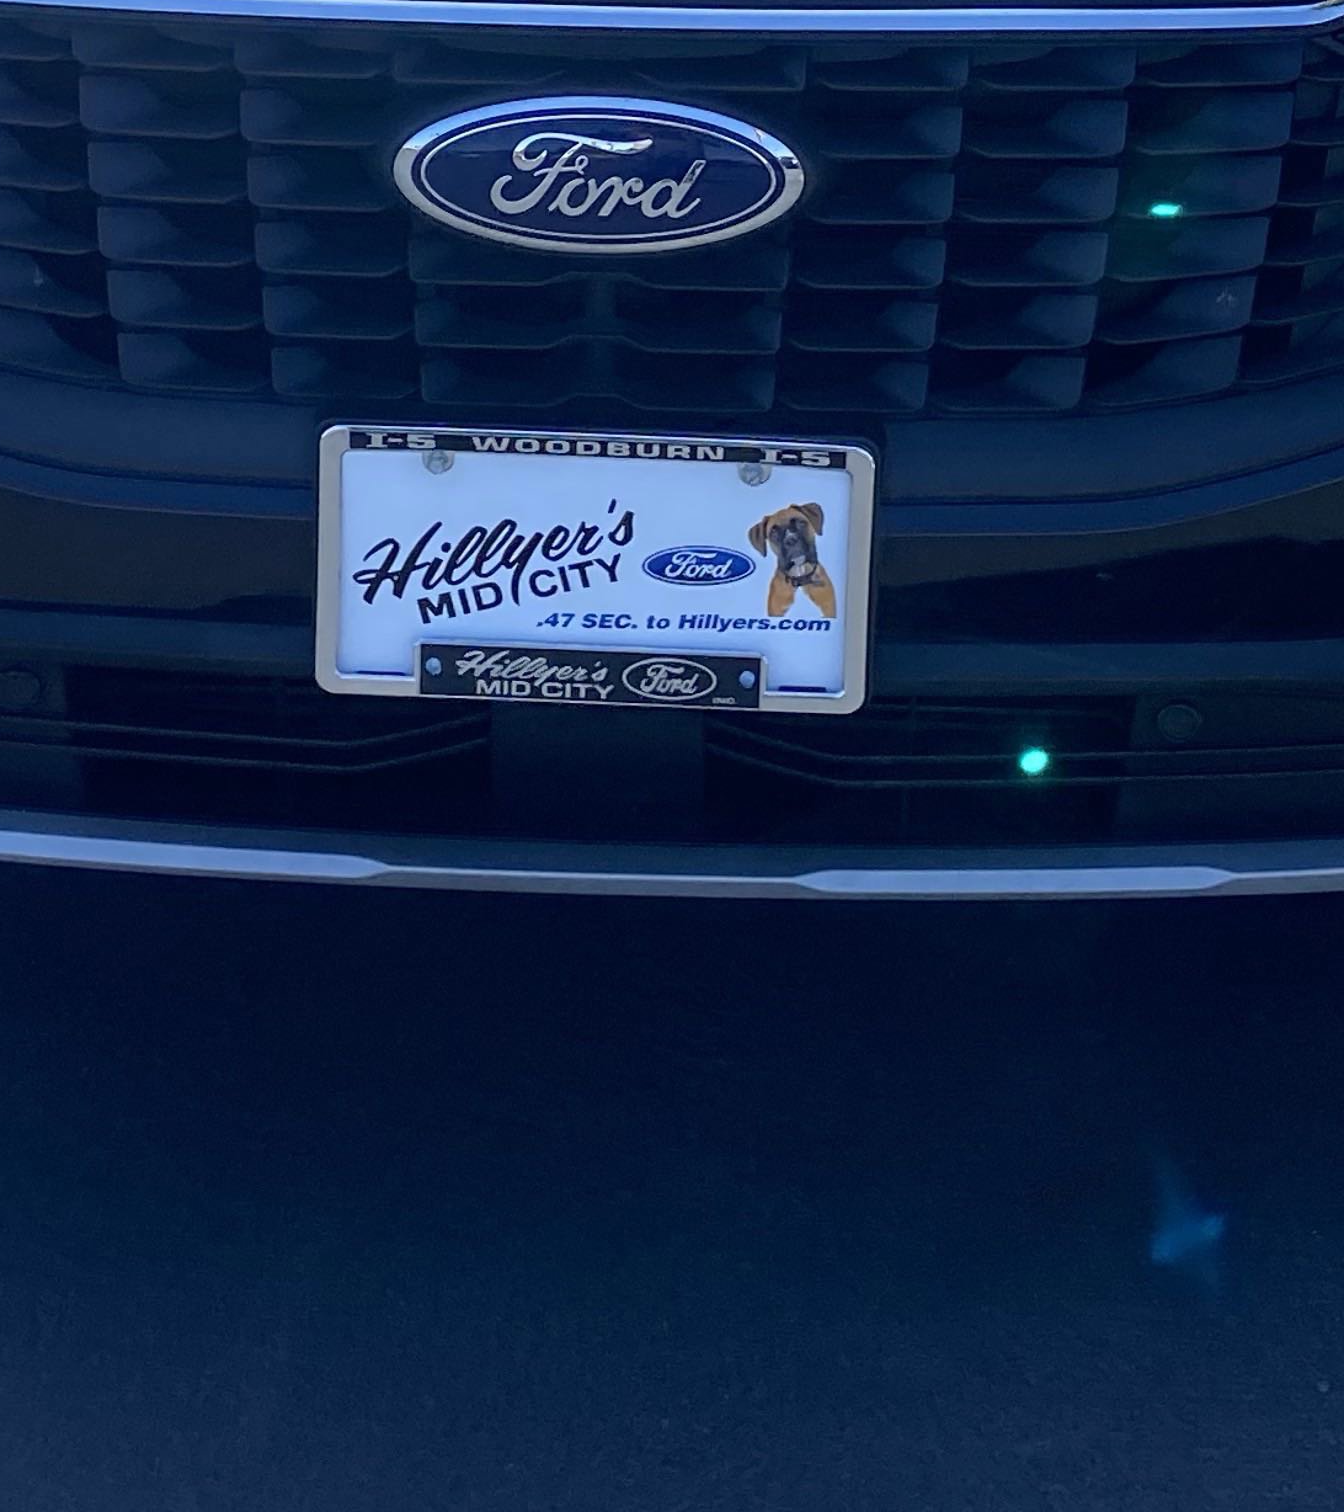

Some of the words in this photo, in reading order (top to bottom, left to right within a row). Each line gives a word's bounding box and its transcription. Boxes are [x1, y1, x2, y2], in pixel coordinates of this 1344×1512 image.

[490, 132, 706, 218] Ford
[366, 433, 437, 449] I-5
[472, 436, 725, 461] WOODBURN
[759, 448, 831, 466] I-5
[353, 499, 634, 606] Hillyer's
[664, 545, 733, 579] Ford
[417, 581, 503, 624] MID
[529, 554, 622, 598] CITY
[536, 614, 576, 628] .47
[582, 614, 639, 630] SEC.
[646, 615, 670, 630] to
[678, 615, 832, 634] Hillyers.com
[455, 650, 610, 687] Hillyer's
[640, 663, 699, 693] Ford
[476, 679, 531, 696] MID
[549, 681, 616, 699] CITY
